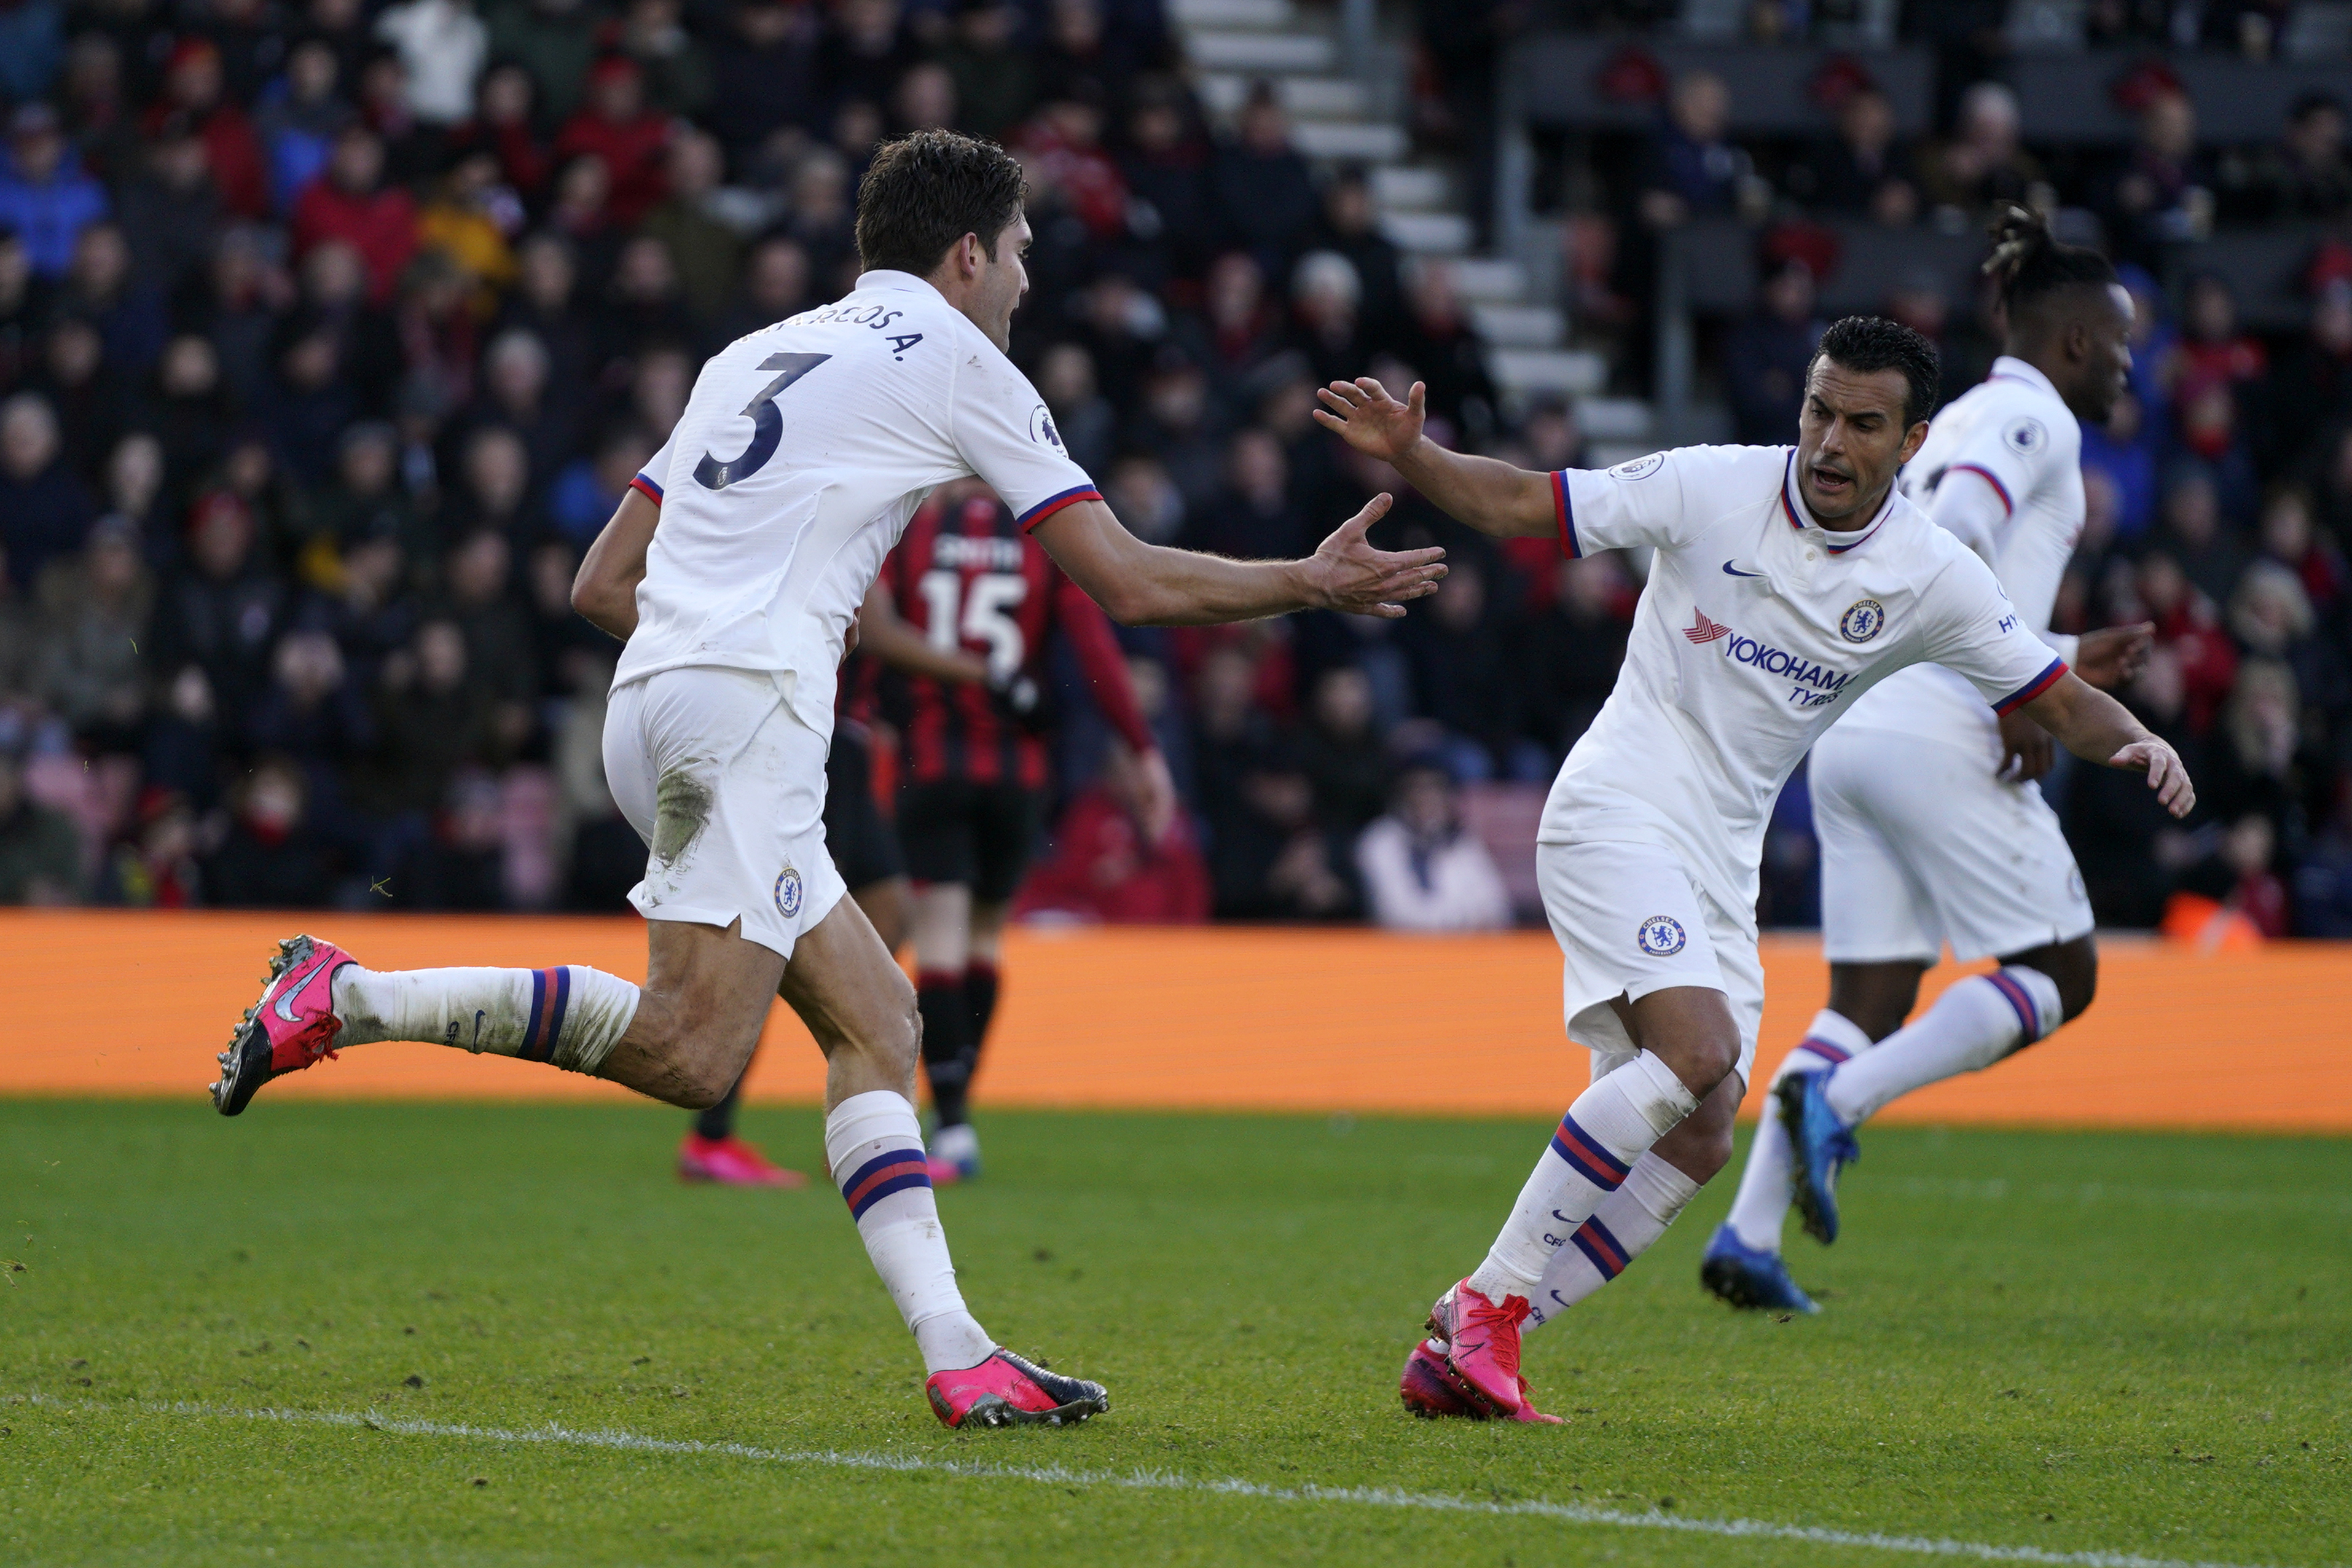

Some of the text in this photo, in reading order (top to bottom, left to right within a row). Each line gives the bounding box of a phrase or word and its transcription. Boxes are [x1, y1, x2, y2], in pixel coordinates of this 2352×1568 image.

[885, 333, 924, 362] A.
[692, 351, 834, 490] 3
[1853, 600, 1881, 612] CHELSEA
[918, 567, 1030, 691] 15
[1643, 917, 1674, 929] CHELSEA
